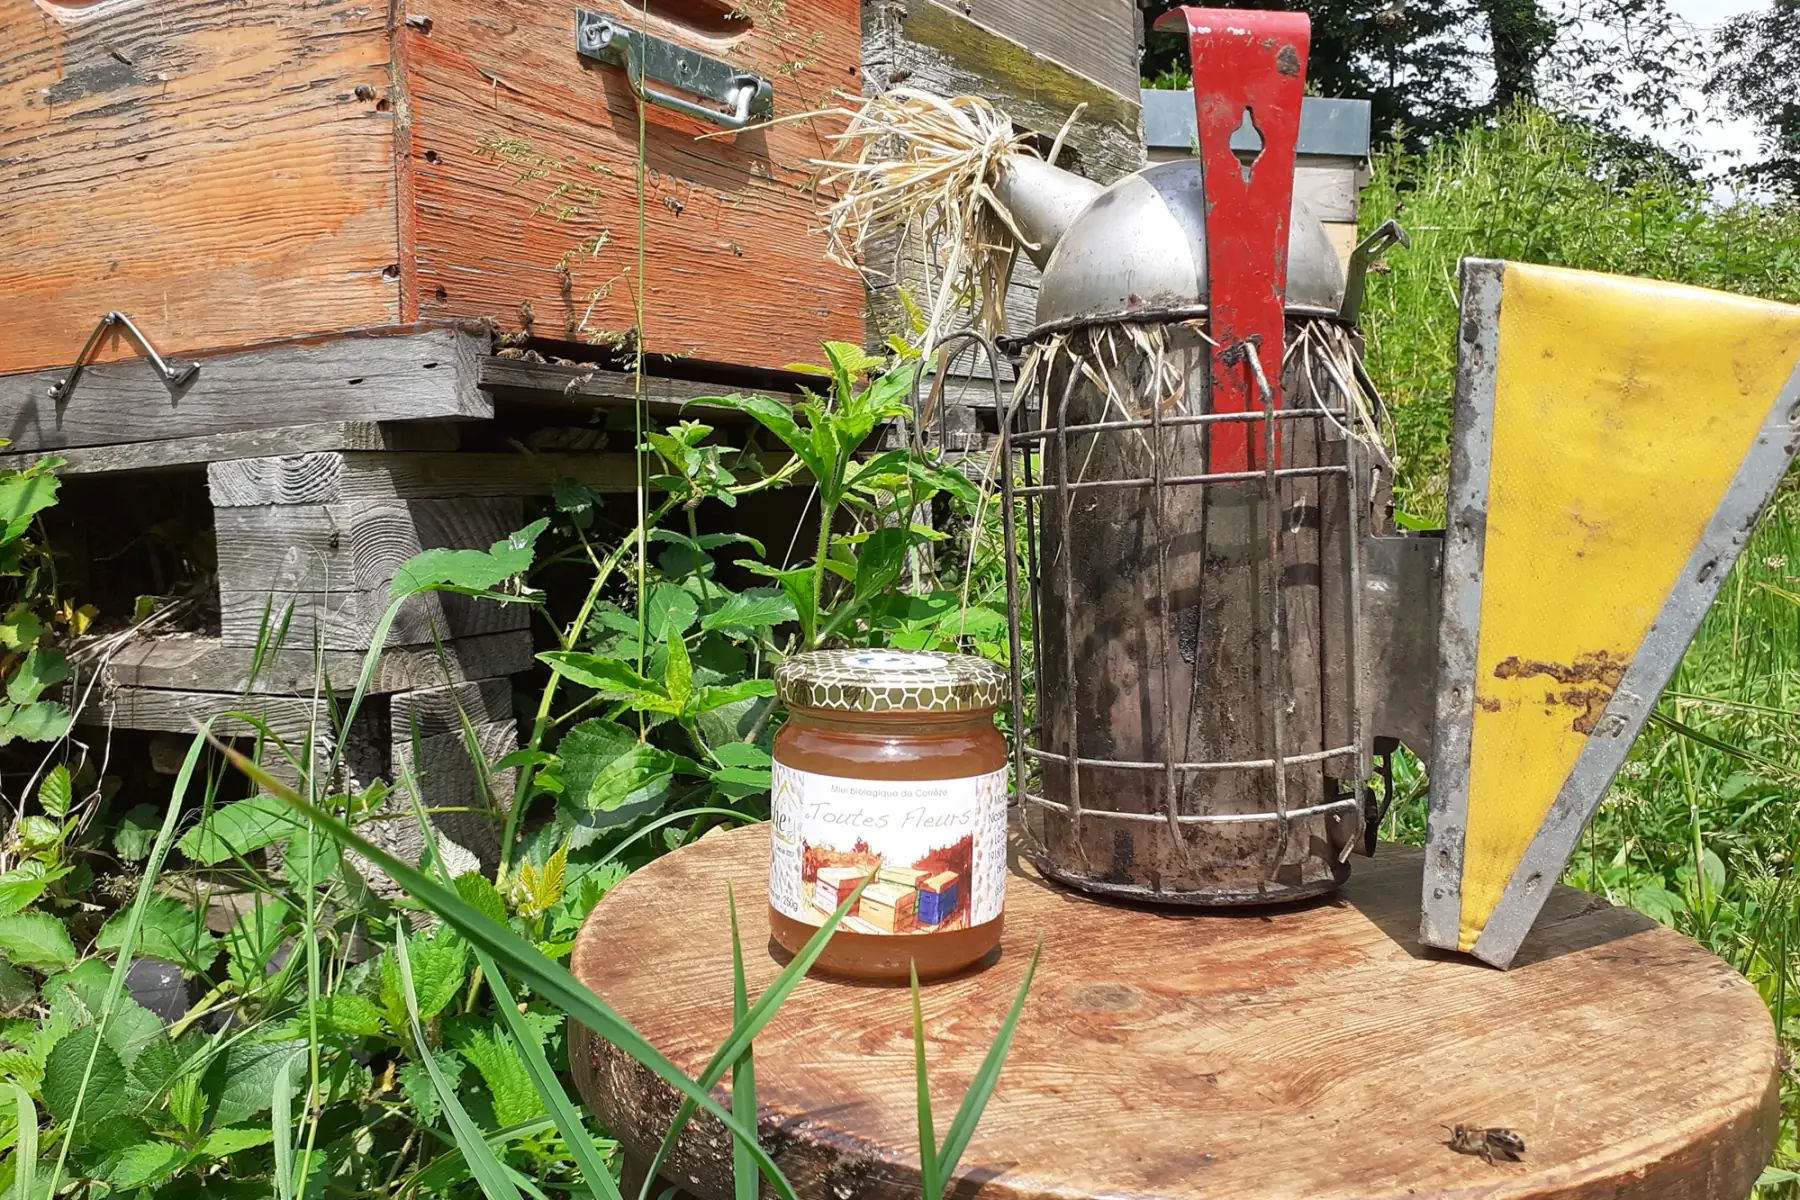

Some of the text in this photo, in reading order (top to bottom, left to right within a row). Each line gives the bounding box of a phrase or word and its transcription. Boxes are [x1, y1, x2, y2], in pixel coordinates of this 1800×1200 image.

[831, 784, 848, 794] Miel
[850, 787, 899, 799] biologique
[901, 788, 913, 798] de
[810, 801, 972, 829] Toutes Fleurs
[783, 895, 798, 912] 250g
